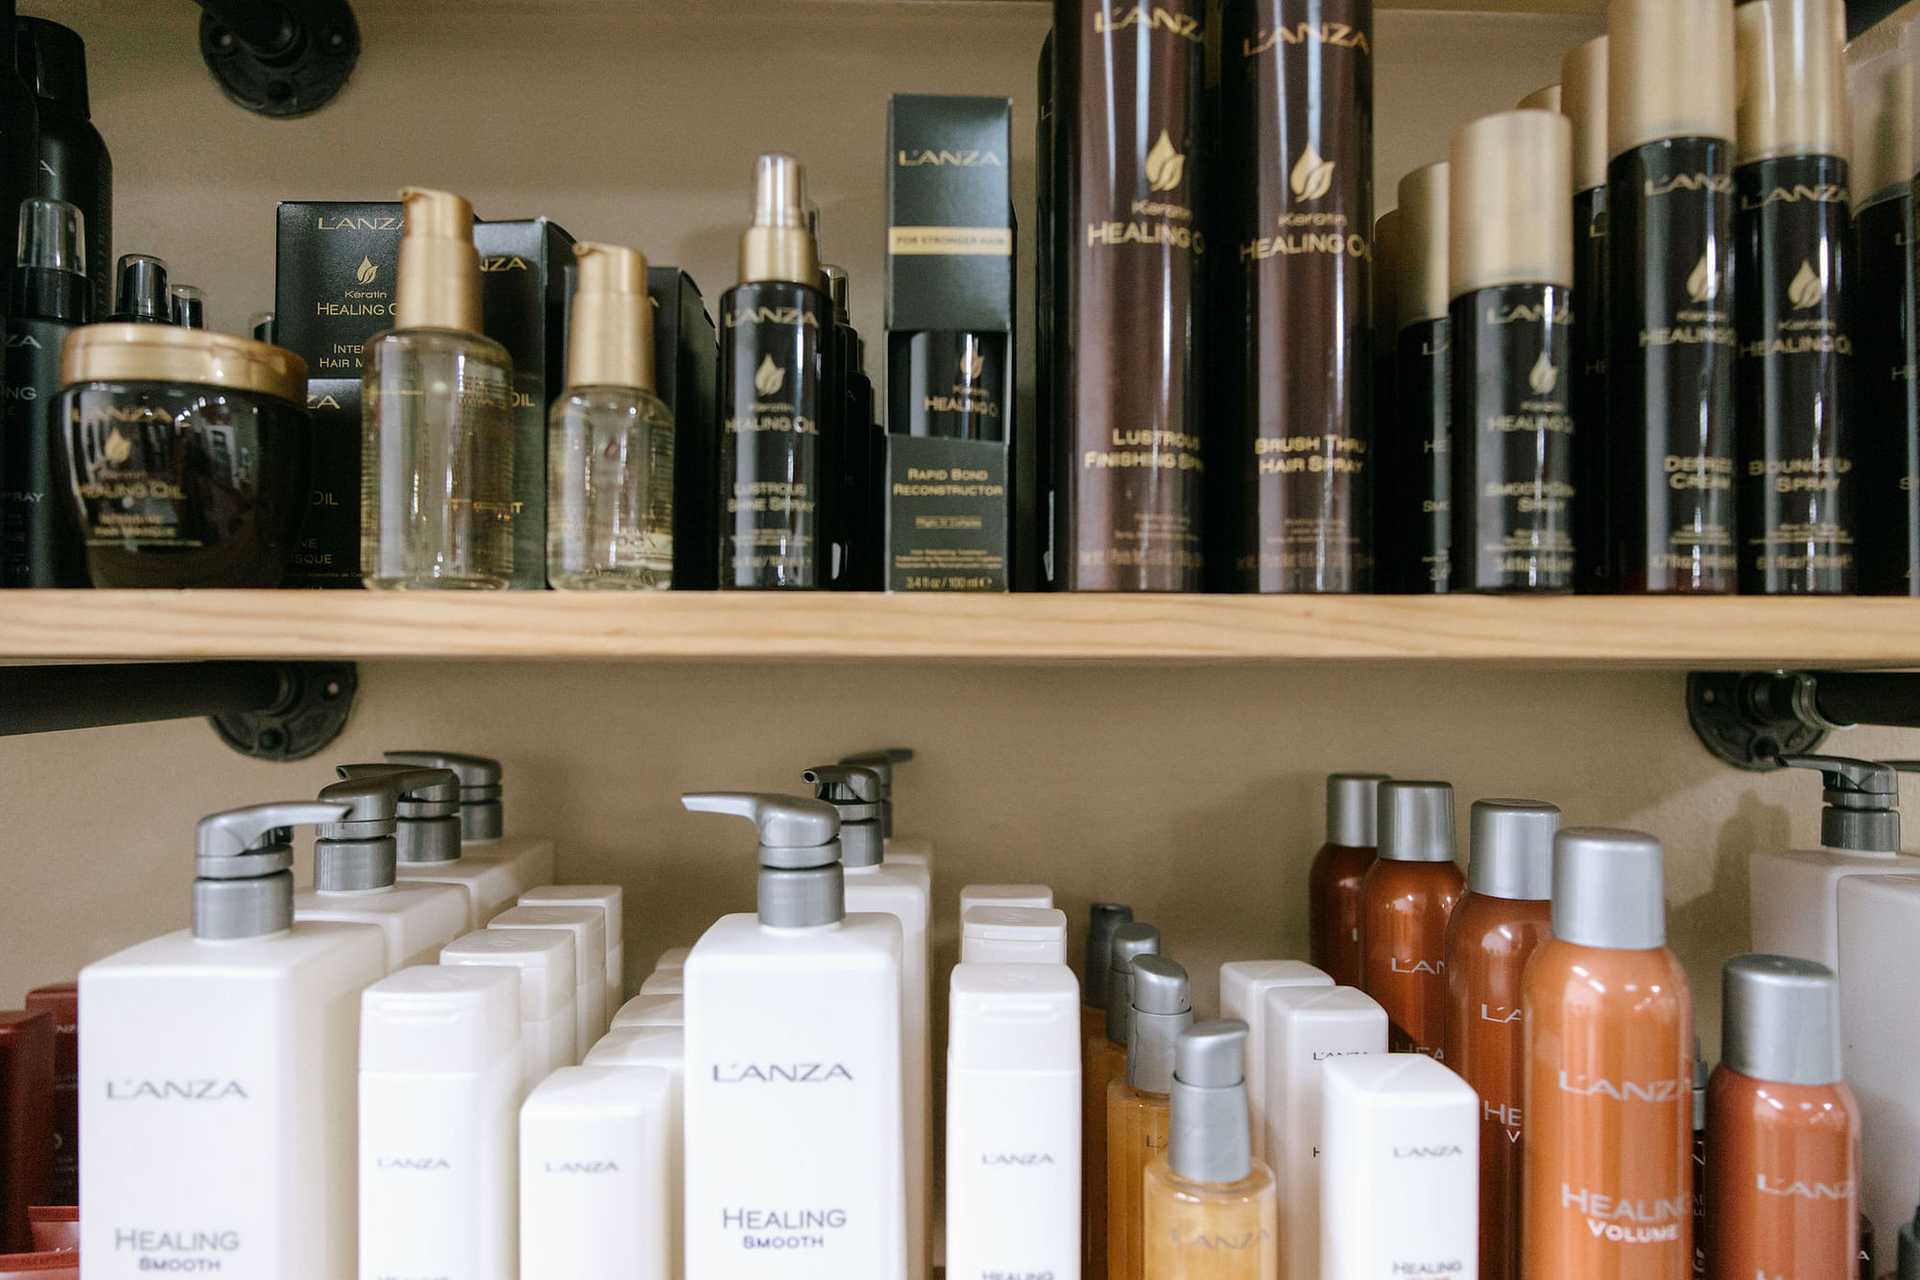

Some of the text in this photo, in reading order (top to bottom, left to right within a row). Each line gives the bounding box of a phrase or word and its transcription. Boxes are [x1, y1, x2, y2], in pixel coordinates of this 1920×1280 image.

[1094, 6, 1202, 42] L'ANZ
[899, 149, 1001, 167] L'ANZA
[1088, 220, 1191, 248] HEALING
[1240, 234, 1345, 263] HEALING
[345, 290, 387, 300] Keratin
[317, 302, 385, 316] HEALING
[319, 358, 350, 368] HAIR
[951, 468, 989, 481] BOND
[893, 483, 1003, 497] RECONSTRUCTOR
[713, 1063, 854, 1082] L'ANZA
[107, 1079, 248, 1099] L'ANZA
[1558, 1071, 1680, 1102] L'ANZ
[722, 1207, 847, 1229] HEALING
[115, 1227, 240, 1252] HEALING
[1587, 1218, 1680, 1243] VOLUME
[743, 1235, 824, 1249] SMOOTH
[139, 1257, 221, 1272] SMOOTH
